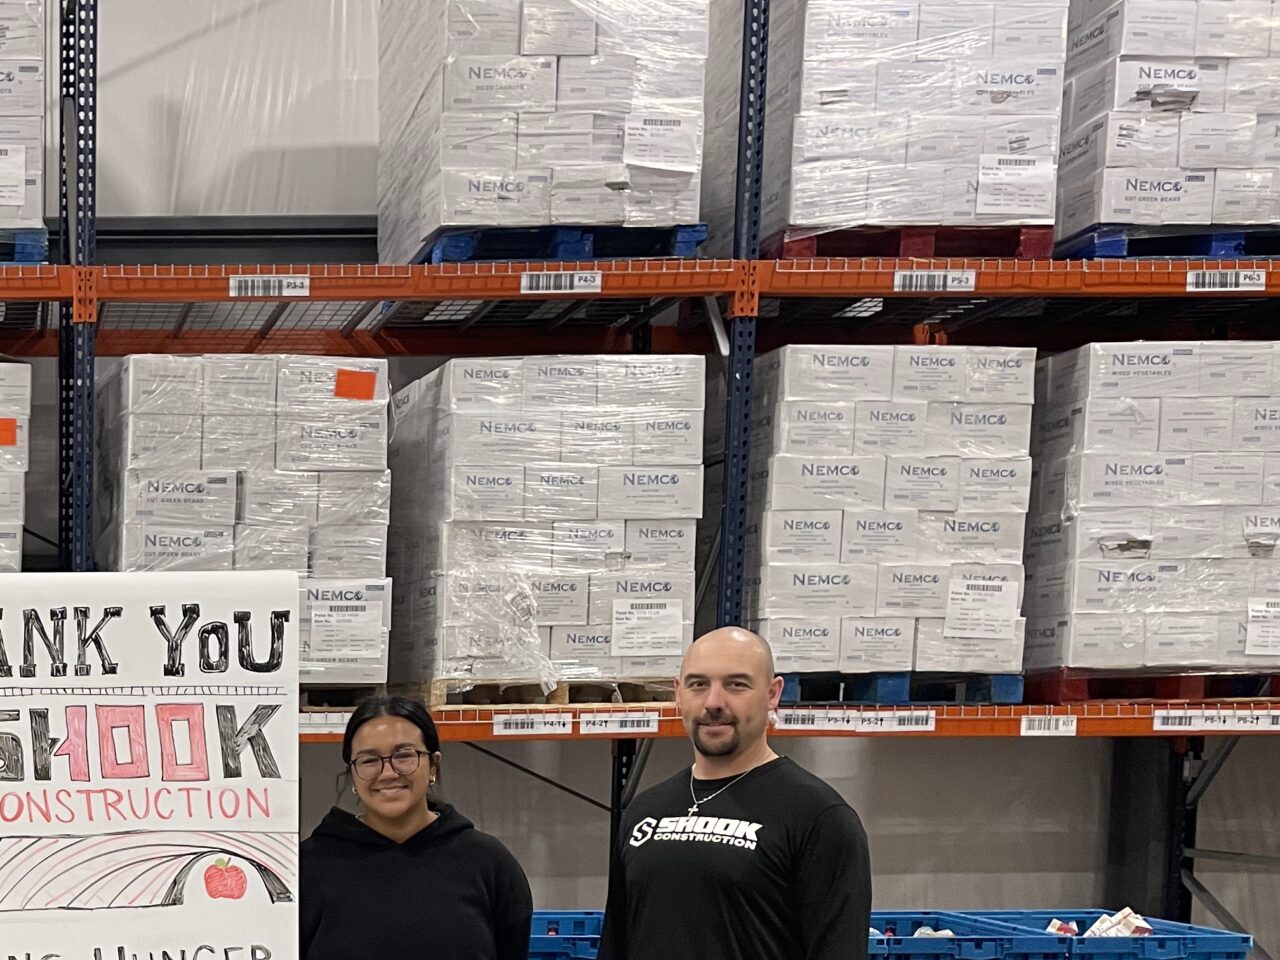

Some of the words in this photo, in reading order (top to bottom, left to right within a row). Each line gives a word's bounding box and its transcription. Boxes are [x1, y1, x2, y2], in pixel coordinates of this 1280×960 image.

[977, 72, 1034, 85] NEMCO
[1139, 67, 1196, 79] NEMCO
[469, 179, 524, 193] NEMCO
[1126, 179, 1182, 192] NEMCO
[578, 275, 596, 283] P4-3
[952, 276, 969, 285] P5-3
[1243, 273, 1261, 281] P6-3
[813, 354, 869, 367] NEMCO
[910, 356, 955, 367] NEMCO
[977, 358, 1022, 368] NEMCO
[1112, 354, 1170, 365] NEMCO
[463, 368, 509, 379] NEMCO
[797, 410, 843, 421] NEMCO
[870, 411, 916, 422] NEMCO
[951, 412, 1007, 425] NEMCO
[480, 421, 536, 433] NEMCO
[646, 421, 691, 431] NEMCO
[802, 464, 860, 476] NEMCO
[901, 465, 947, 476] NEMCO
[970, 468, 1016, 478] NEMCO
[1105, 464, 1163, 475] NEMCO
[466, 475, 512, 486] NEMCO
[623, 473, 679, 486] NEMCO
[148, 481, 204, 493] NEMCO
[783, 520, 830, 530] NEMCO
[856, 520, 903, 531] NEMCO
[944, 520, 1000, 532] NEMCO
[1245, 515, 1280, 528] NEM
[569, 528, 614, 539] NEMCO
[639, 528, 684, 539] NEMCO
[145, 534, 202, 547] NEMCO
[793, 573, 851, 586] NEMCO
[892, 573, 939, 584] NEMCO
[532, 581, 577, 592] NEMCO
[617, 581, 672, 592] NEMCO
[308, 589, 363, 600] NEMCO
[783, 627, 829, 637] NEMCO
[855, 626, 901, 637] NEMCO
[1237, 716, 1255, 724] P6-2
[656, 816, 763, 842] SHOOK
[653, 832, 757, 850] CONSTRUCTION
